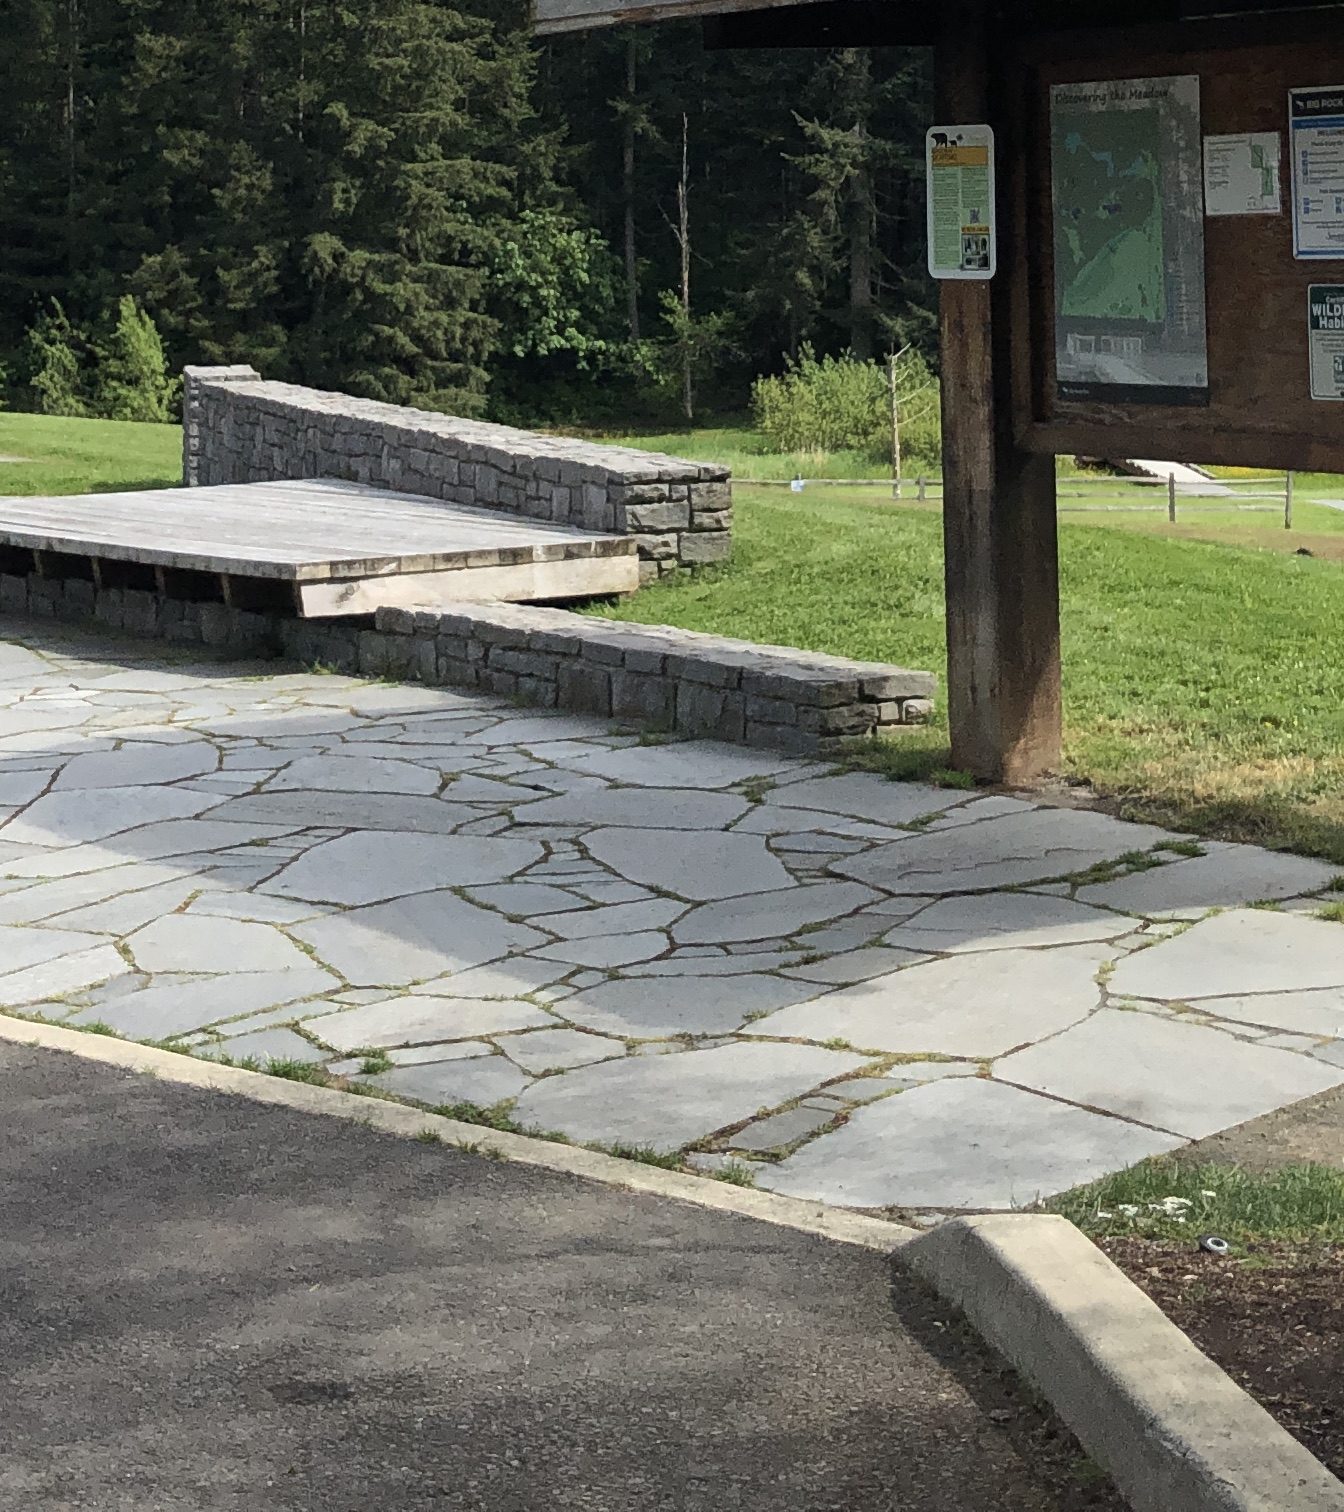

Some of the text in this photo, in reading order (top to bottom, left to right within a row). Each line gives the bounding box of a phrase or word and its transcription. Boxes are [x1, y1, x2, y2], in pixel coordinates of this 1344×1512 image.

[1055, 91, 1106, 105] Discovering
[1110, 89, 1125, 100] the
[1321, 98, 1344, 108] ROCK
